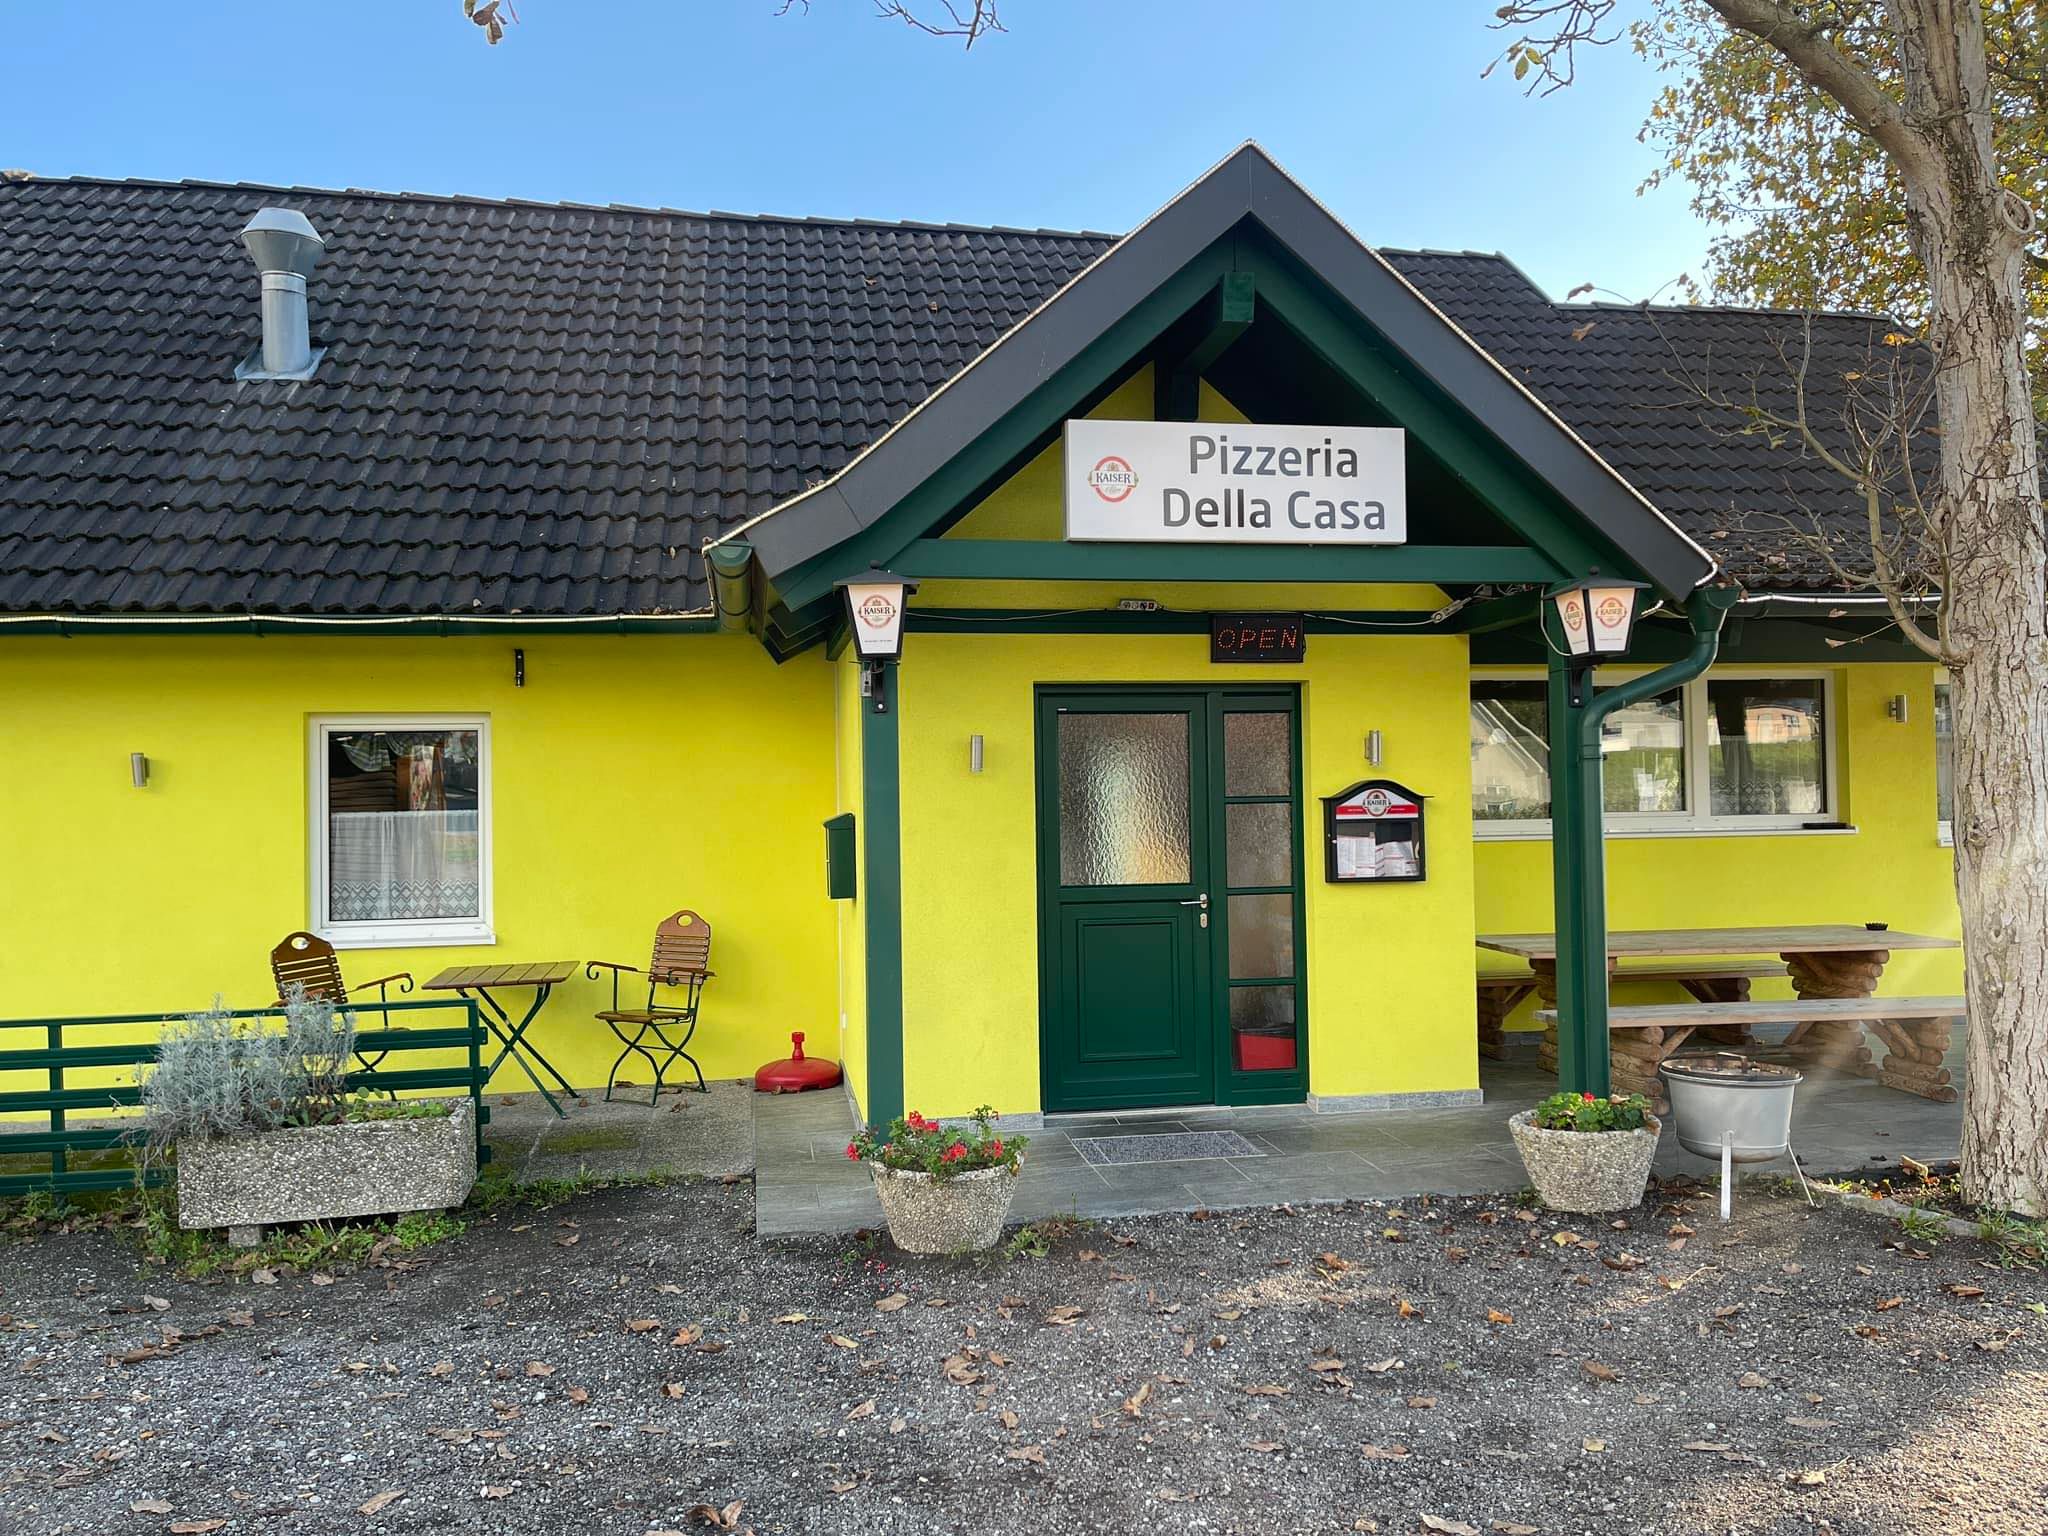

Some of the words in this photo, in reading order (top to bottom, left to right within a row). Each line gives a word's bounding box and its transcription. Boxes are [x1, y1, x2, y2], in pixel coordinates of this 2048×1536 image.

[1189, 435, 1358, 478] Pizzeria
[1096, 472, 1131, 484] KAISER
[1163, 488, 1272, 529] Della
[1287, 490, 1386, 530] Casa
[864, 607, 890, 615] KAISER
[1600, 608, 1622, 616] KAISER
[1217, 629, 1297, 649] OPEN
[1366, 798, 1387, 806] KAISER
